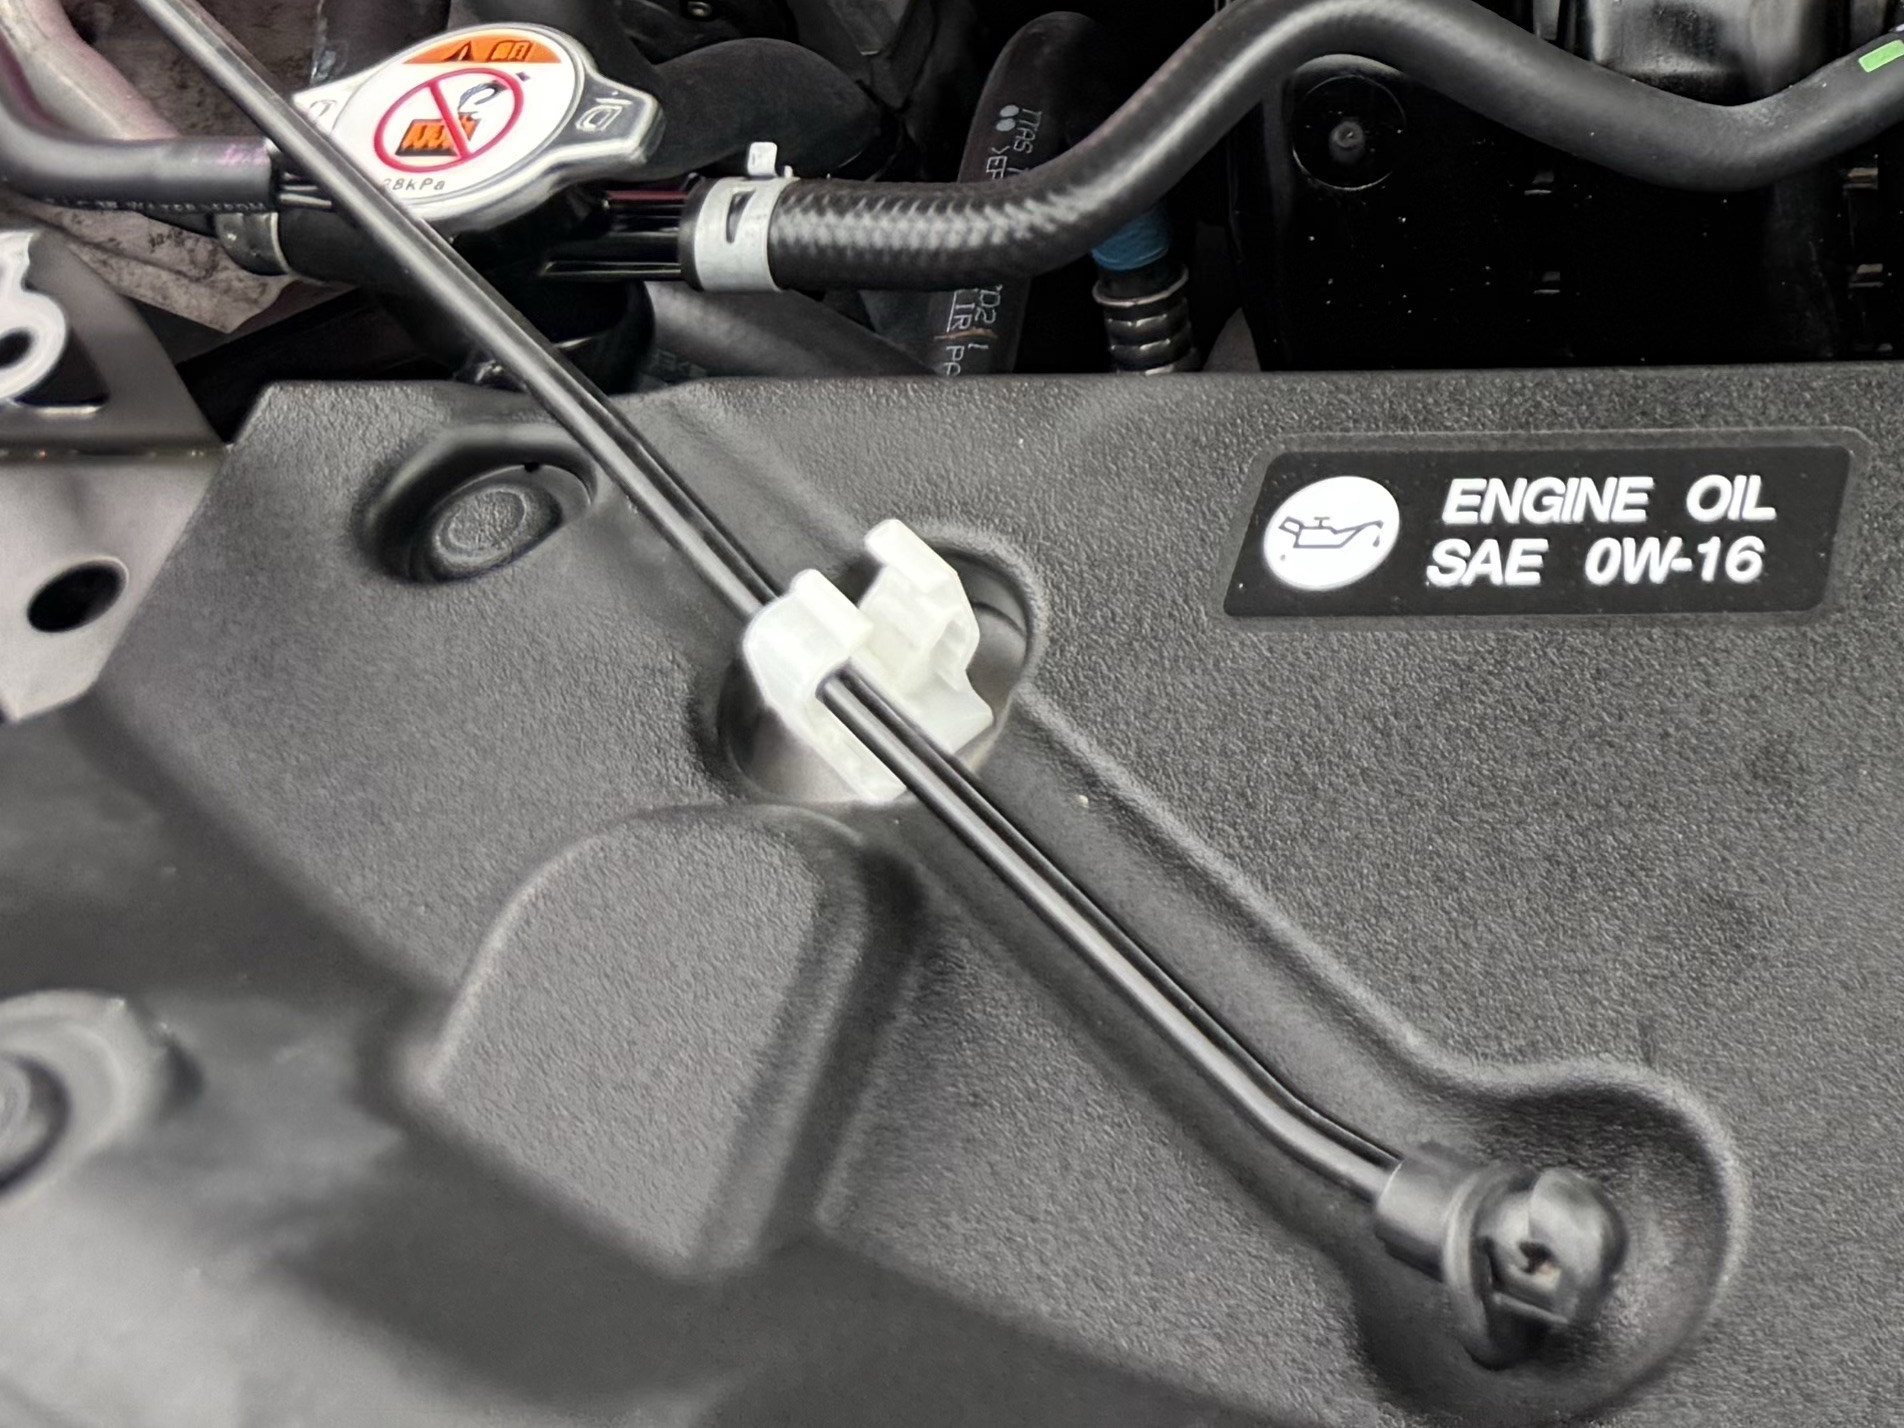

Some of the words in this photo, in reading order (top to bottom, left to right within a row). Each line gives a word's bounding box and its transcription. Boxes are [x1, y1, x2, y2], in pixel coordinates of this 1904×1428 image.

[1441, 476, 1654, 525] ENGINE
[1686, 475, 1777, 523] OIL
[1426, 537, 1549, 587] SAE
[1584, 535, 1765, 586] 0W-16
